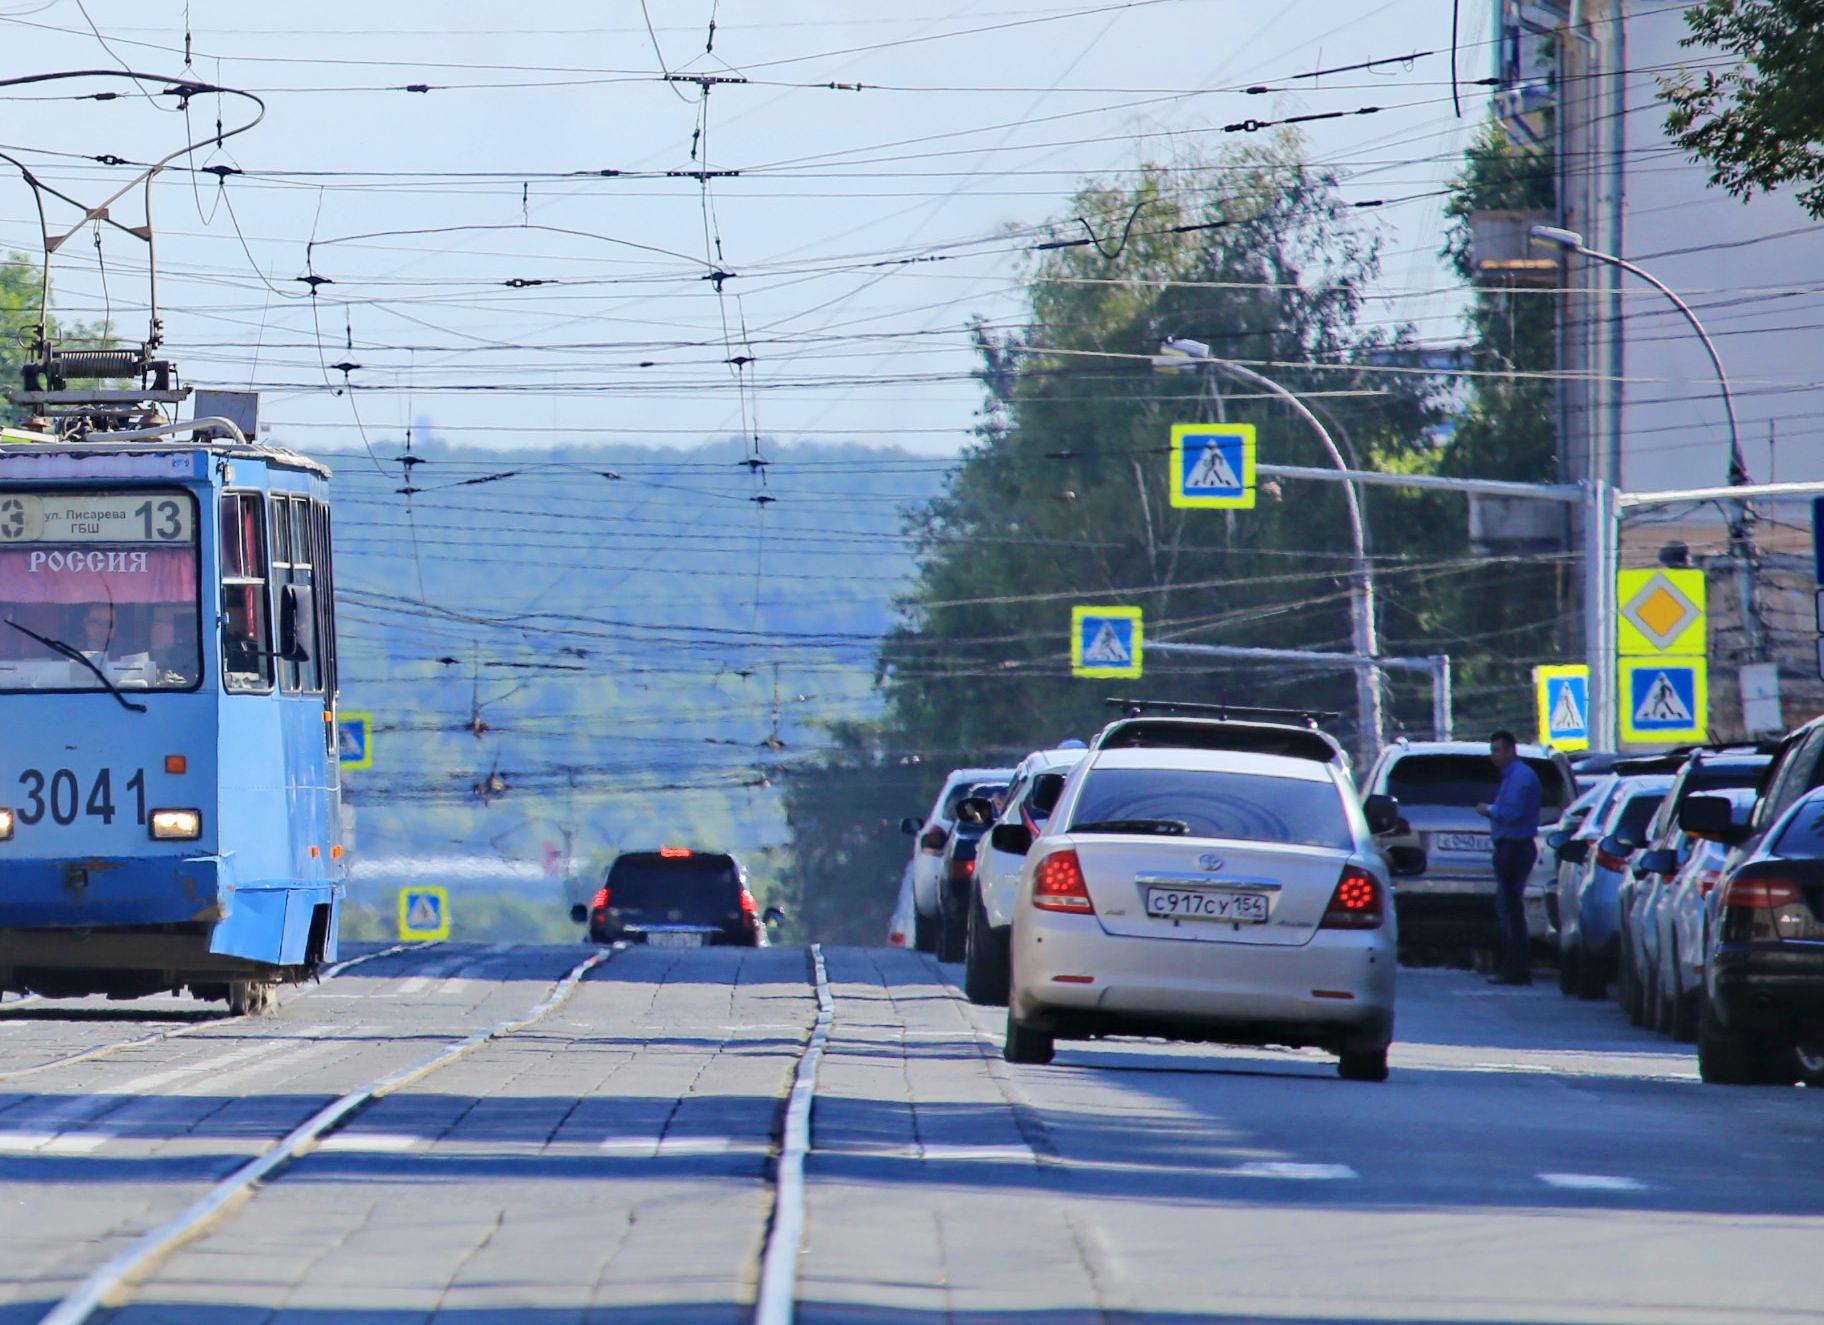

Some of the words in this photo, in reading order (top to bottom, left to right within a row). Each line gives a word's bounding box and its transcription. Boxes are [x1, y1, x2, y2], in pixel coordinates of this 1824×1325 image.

[66, 510, 126, 522] Писарева
[134, 501, 182, 540] 13
[71, 523, 100, 534] ГБШ
[28, 551, 149, 573] РОССИЯ
[16, 767, 146, 826] 3041
[1154, 893, 1229, 915] С917СУ
[1233, 896, 1262, 912] 154
